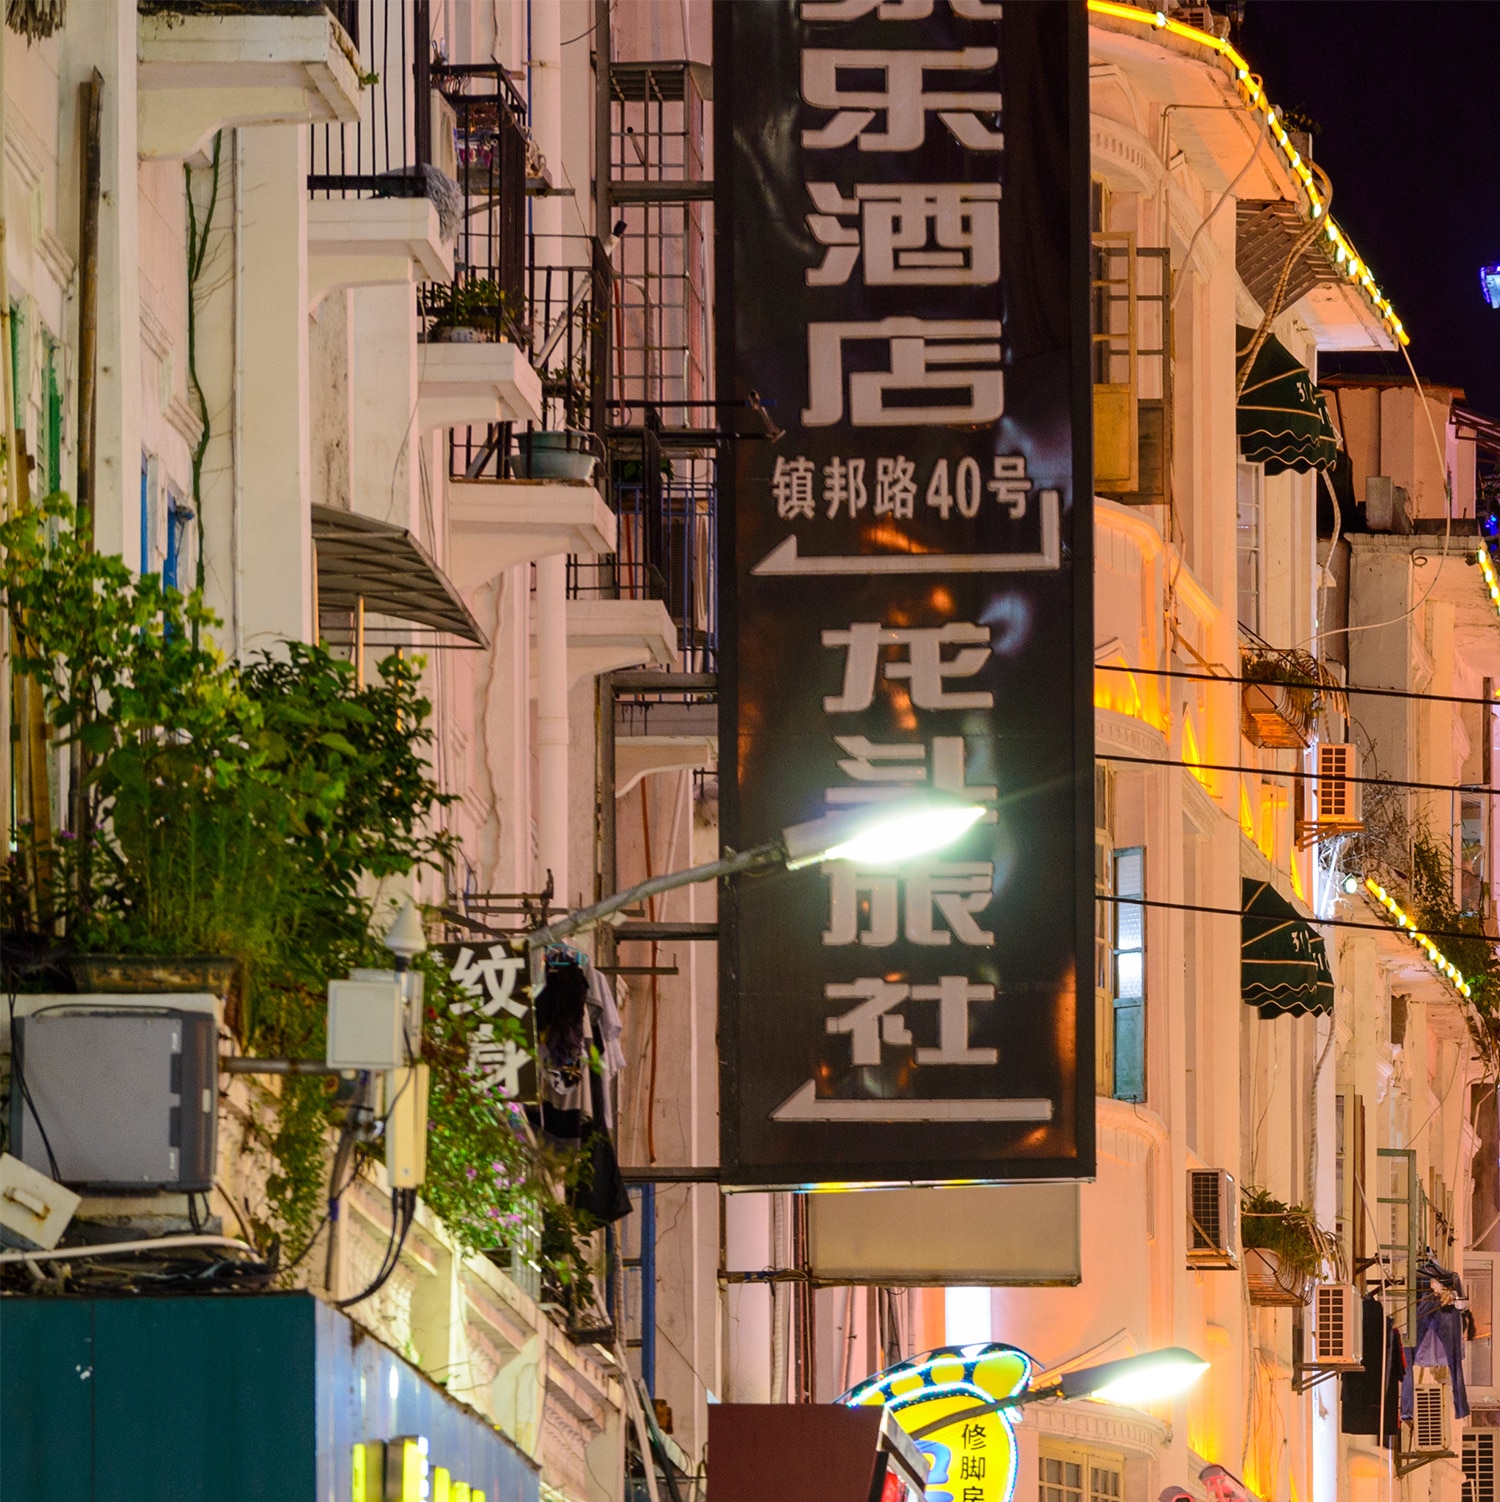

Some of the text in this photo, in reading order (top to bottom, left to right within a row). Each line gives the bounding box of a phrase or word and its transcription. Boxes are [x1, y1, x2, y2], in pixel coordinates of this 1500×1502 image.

[800, 0, 1005, 427] 乐酒店
[771, 455, 1033, 520] 镇邦路40号
[449, 944, 532, 1098] 纹身
